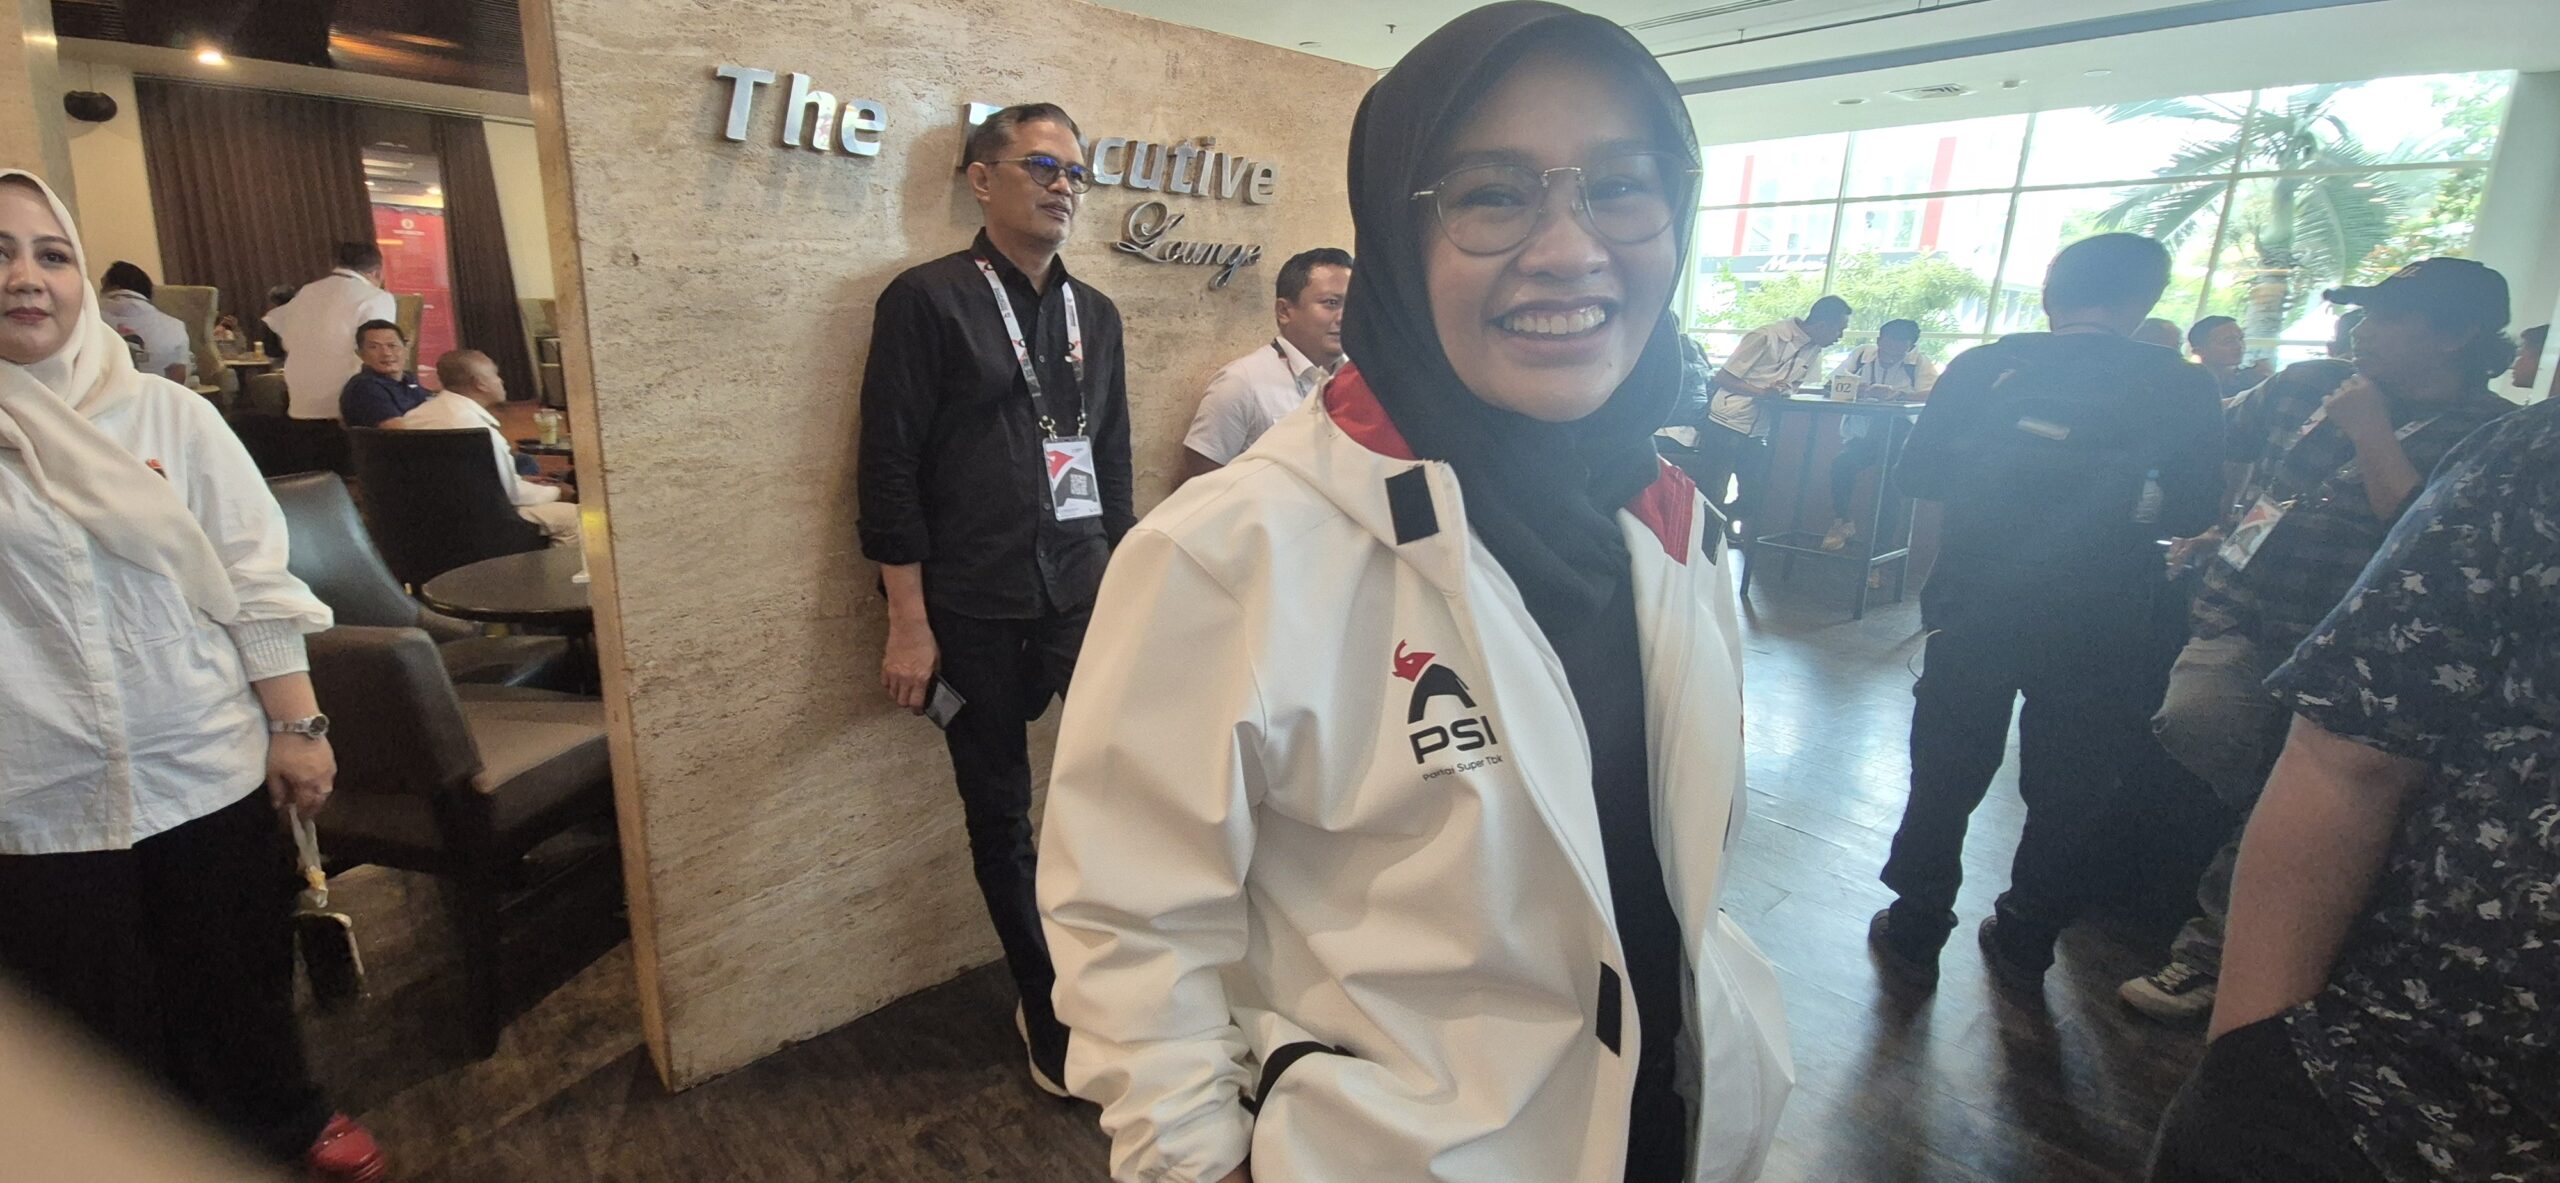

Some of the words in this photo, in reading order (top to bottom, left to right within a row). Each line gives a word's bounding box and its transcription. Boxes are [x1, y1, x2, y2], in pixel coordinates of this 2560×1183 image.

[716, 64, 888, 156] The
[956, 101, 1279, 204] cutive
[1110, 200, 1263, 291] Lounge
[1835, 382, 1851, 393] 02
[1409, 715, 1498, 765] PSI
[1456, 759, 1484, 773] Super
[1485, 754, 1503, 765] Tbk
